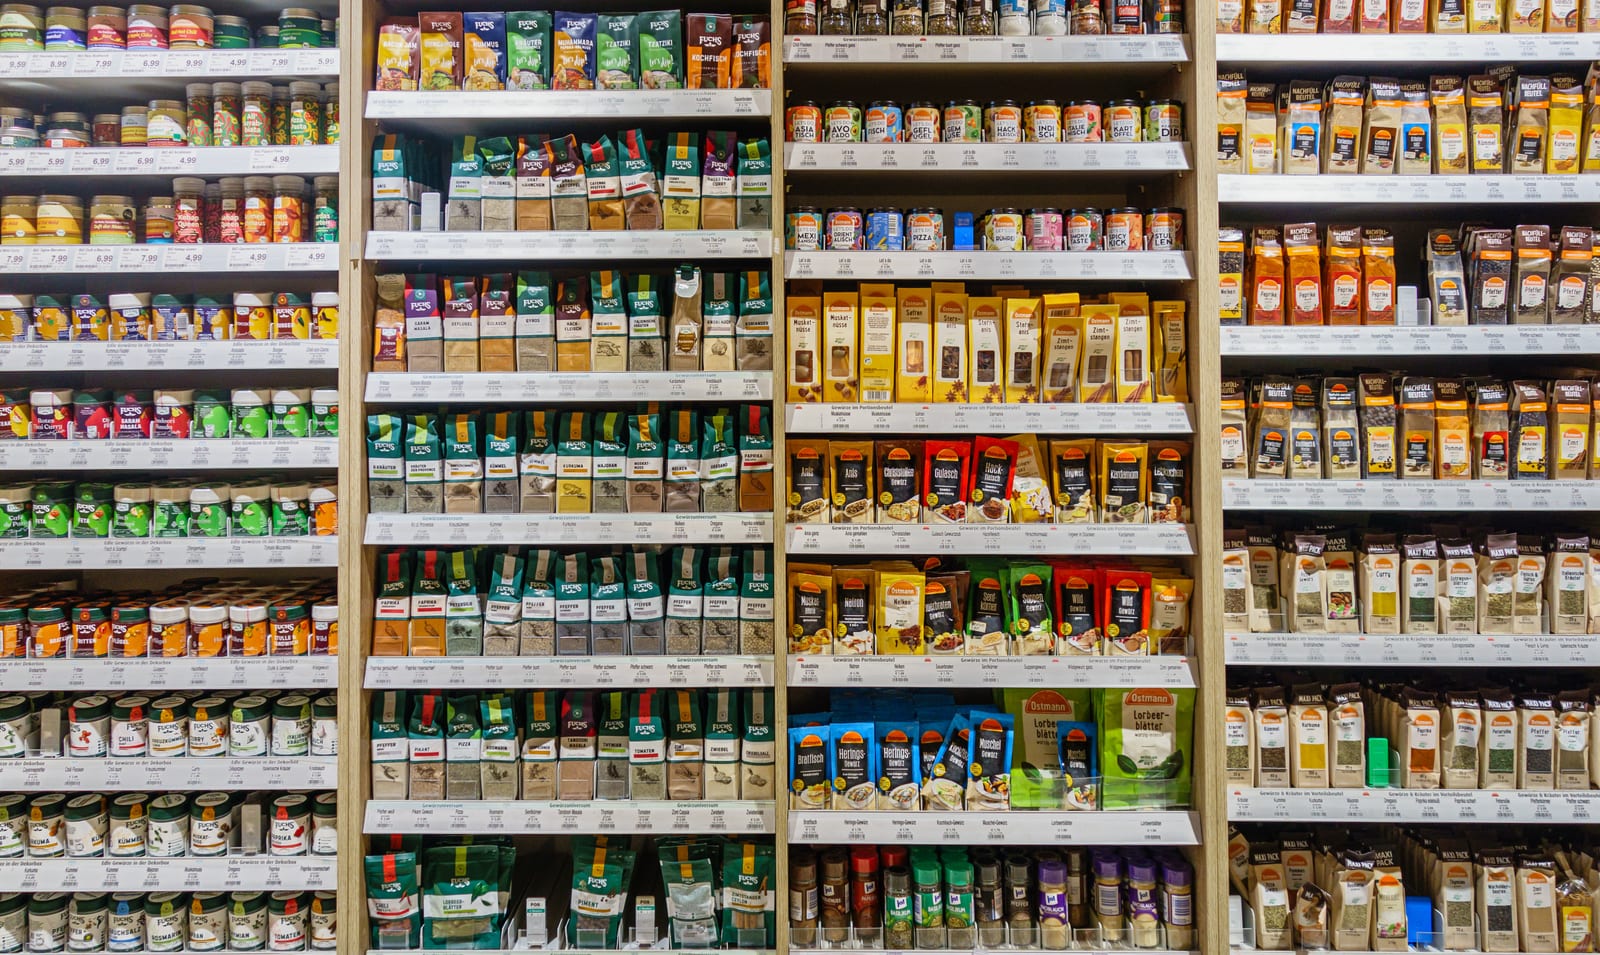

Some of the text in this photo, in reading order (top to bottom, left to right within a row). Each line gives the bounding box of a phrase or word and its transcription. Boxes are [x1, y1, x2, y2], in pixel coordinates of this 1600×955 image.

[1477, 2, 1491, 10] Curry
[518, 20, 538, 28] FUCHS
[699, 36, 722, 45] FUCHS
[738, 33, 760, 42] FUCHS
[606, 40, 631, 48] TZATZIKI
[648, 39, 673, 47] TZATZIKI
[691, 54, 727, 63] KOCHFISCH
[1335, 81, 1361, 89] NACHFÜLL
[868, 127, 885, 135] FISCH
[626, 161, 645, 169] FUCHS
[672, 161, 692, 169] FUCHS
[411, 302, 431, 312] FUCHS
[1404, 384, 1430, 392] NACHFÜLL
[1408, 391, 1428, 399] BEUTEL
[375, 443, 395, 452] FUCHS
[490, 441, 510, 451] FUCHS
[636, 441, 657, 451] FUCHS
[845, 468, 858, 478] Anis
[935, 468, 959, 479] Gulasch
[1327, 538, 1346, 546] MAXI
[1423, 548, 1437, 557] PACK
[1376, 571, 1391, 579] Curry
[561, 584, 582, 593] FUCHS
[633, 582, 653, 592] FUCHS
[749, 582, 769, 592] FUCHS
[1121, 596, 1133, 607] Wild
[274, 623, 295, 634] FUCHS
[1131, 694, 1168, 703] Ostmann
[1031, 702, 1065, 711] Ostmann
[1133, 710, 1169, 720] Lorbeer-
[127, 723, 147, 731] FUCHS
[194, 722, 213, 732] FUCHS
[232, 723, 250, 733] FUCHS
[568, 721, 588, 730] FUCHS
[712, 724, 732, 733] FUCHS
[1135, 720, 1163, 730] blätter
[635, 725, 655, 735] FUCHS
[748, 726, 768, 735] FUCHS
[979, 739, 1001, 750] Muschel
[839, 748, 866, 759] Herings-
[884, 747, 910, 758] Herings-
[798, 753, 823, 764] Bratfisch
[198, 822, 219, 831] FUCHS
[275, 821, 294, 831] FUCHS
[118, 836, 143, 844] KÜMMEL
[1377, 858, 1394, 866] PACK
[588, 877, 607, 888] FUCHS
[738, 875, 758, 885] FUCHS
[113, 916, 133, 926] FUCHS
[232, 916, 250, 926] FUCHS
[281, 914, 301, 925] FUCHS
[275, 931, 300, 940] TOMATEN
